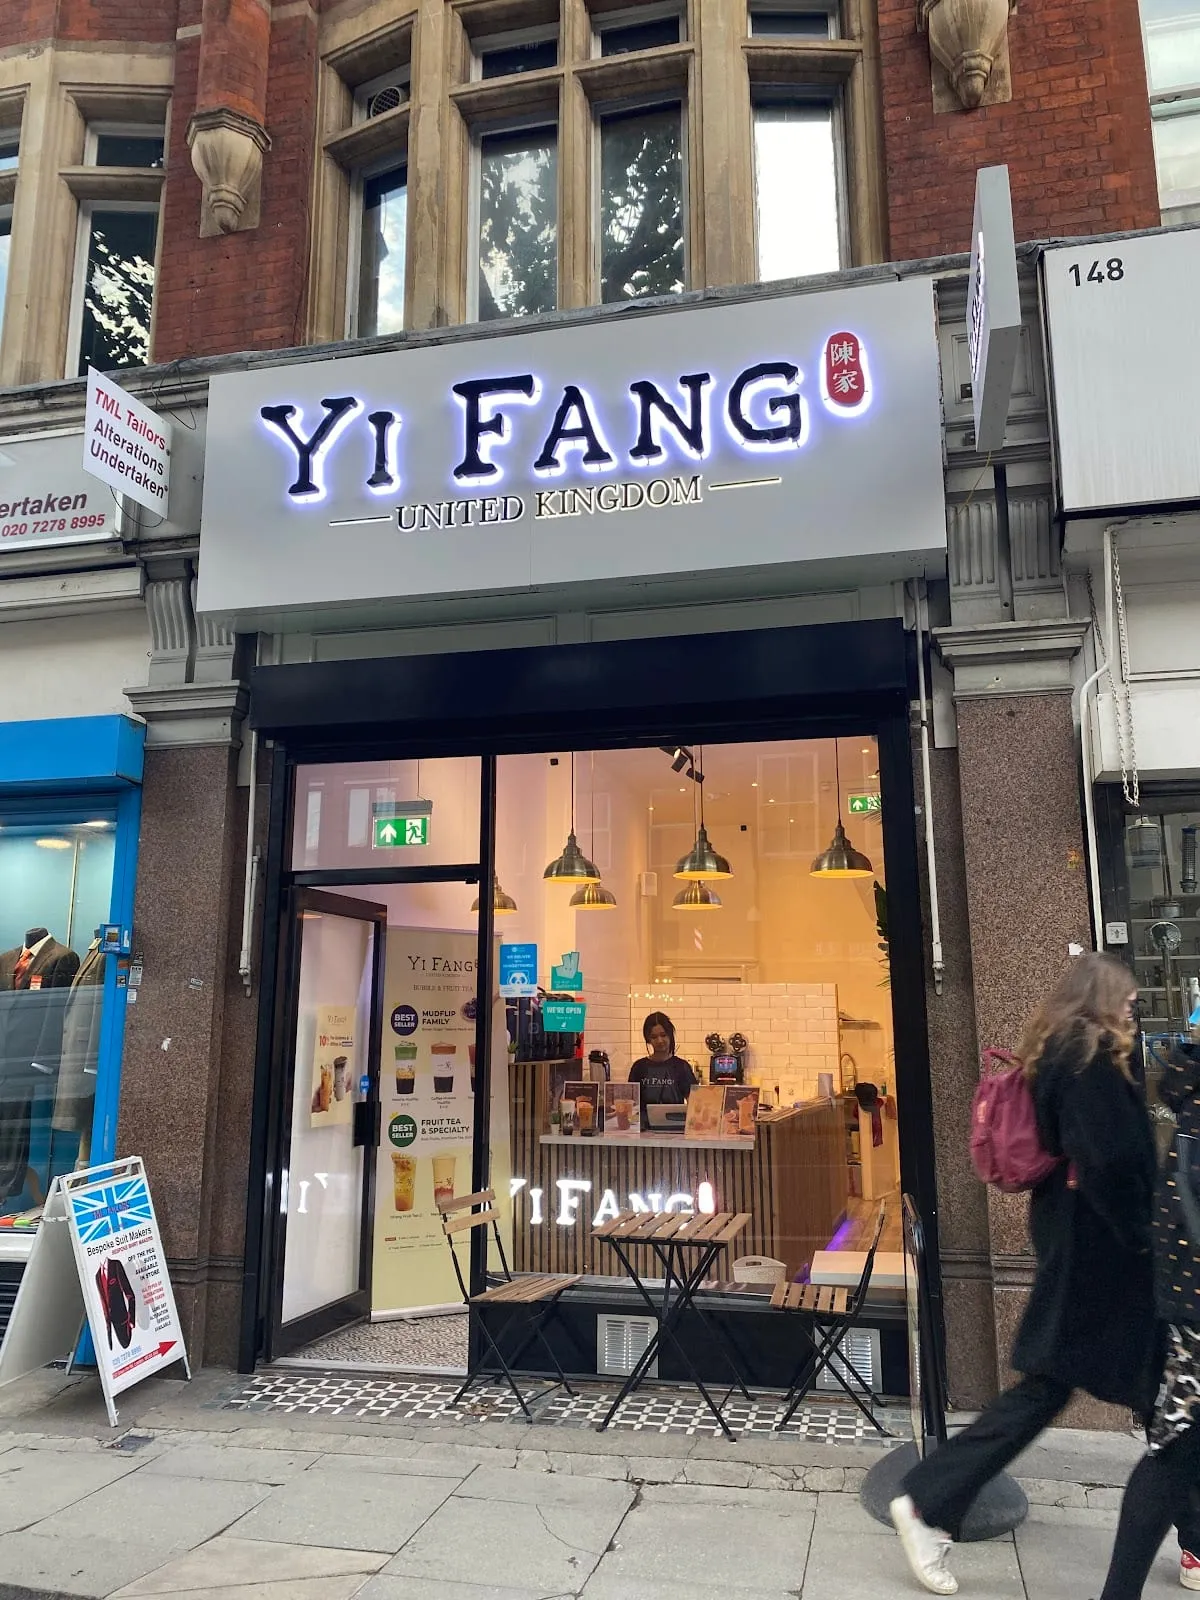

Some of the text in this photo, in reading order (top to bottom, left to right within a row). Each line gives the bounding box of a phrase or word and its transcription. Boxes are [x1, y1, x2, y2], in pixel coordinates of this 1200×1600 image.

[1068, 257, 1124, 287] 148
[830, 341, 859, 394] 陳家
[95, 387, 165, 451] TML Tailors
[260, 361, 803, 498] YI FANG
[94, 418, 164, 476] Alterations
[90, 439, 164, 499] Undertaken
[396, 476, 702, 531] UNITED KINGDOM
[2, 513, 105, 537] 020 7278 8995
[408, 955, 426, 971] YI
[431, 957, 473, 972] FANG
[394, 1013, 415, 1021] BEST
[546, 1006, 582, 1015] WE'RE OPEN
[651, 1077, 673, 1085] FANG
[392, 1124, 414, 1132] BEST
[428, 1126, 470, 1135] SPECIALTY
[86, 1241, 115, 1257] Bespoke
[115, 1235, 128, 1247] Suit
[129, 1227, 152, 1241] Makers
[136, 1251, 145, 1259] THE
[143, 1255, 157, 1264] SUITS
[135, 1262, 158, 1275] AVAILABLE
[145, 1269, 160, 1280] STORE
